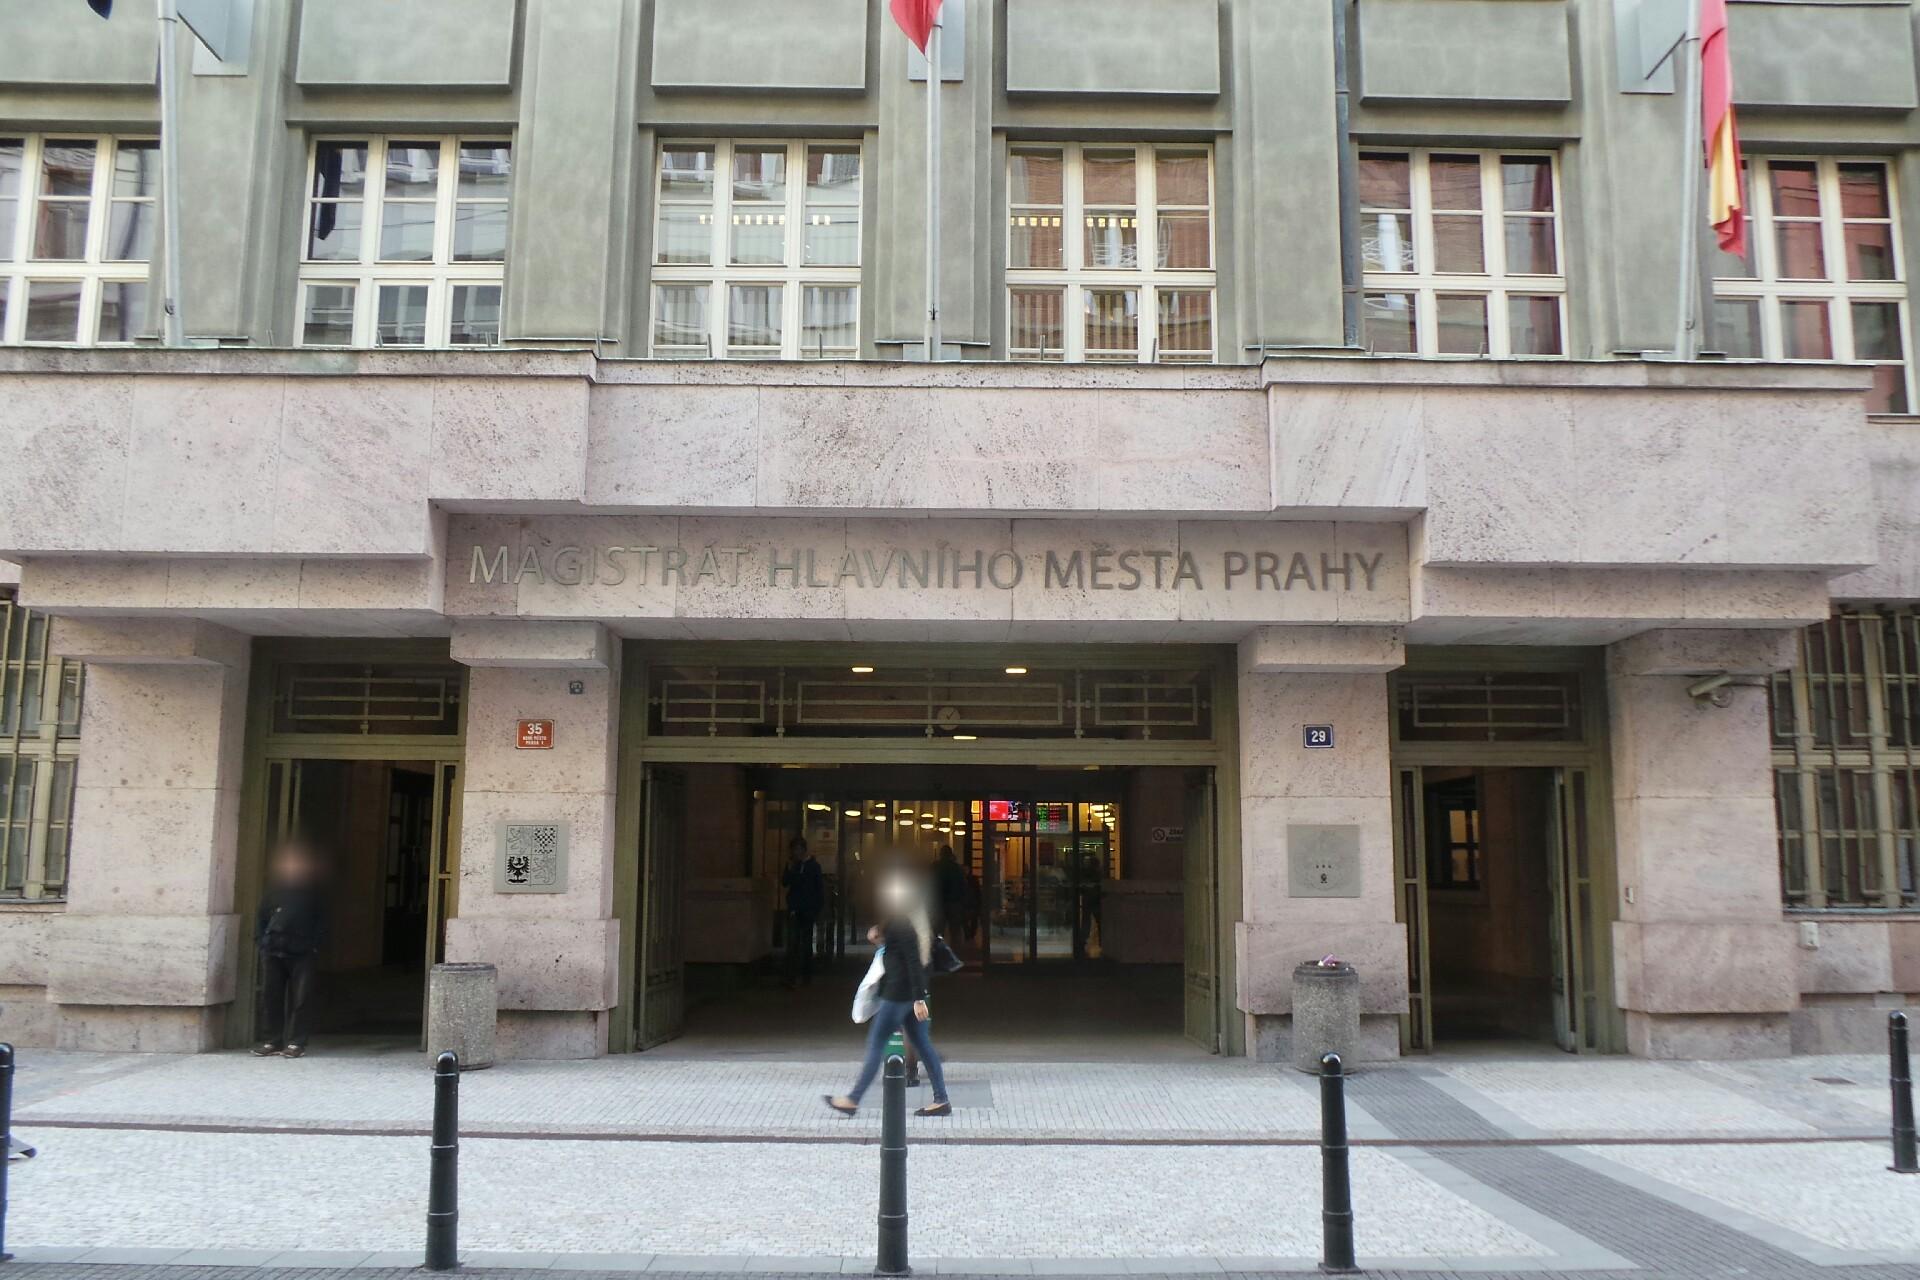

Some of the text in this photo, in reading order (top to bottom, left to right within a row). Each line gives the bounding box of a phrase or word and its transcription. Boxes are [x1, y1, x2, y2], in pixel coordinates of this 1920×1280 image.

[469, 539, 1383, 591] MAGISTRÁT HLAVNÍHO MĚSTA PRAHY
[528, 723, 542, 734] 35
[1311, 730, 1326, 743] 29
